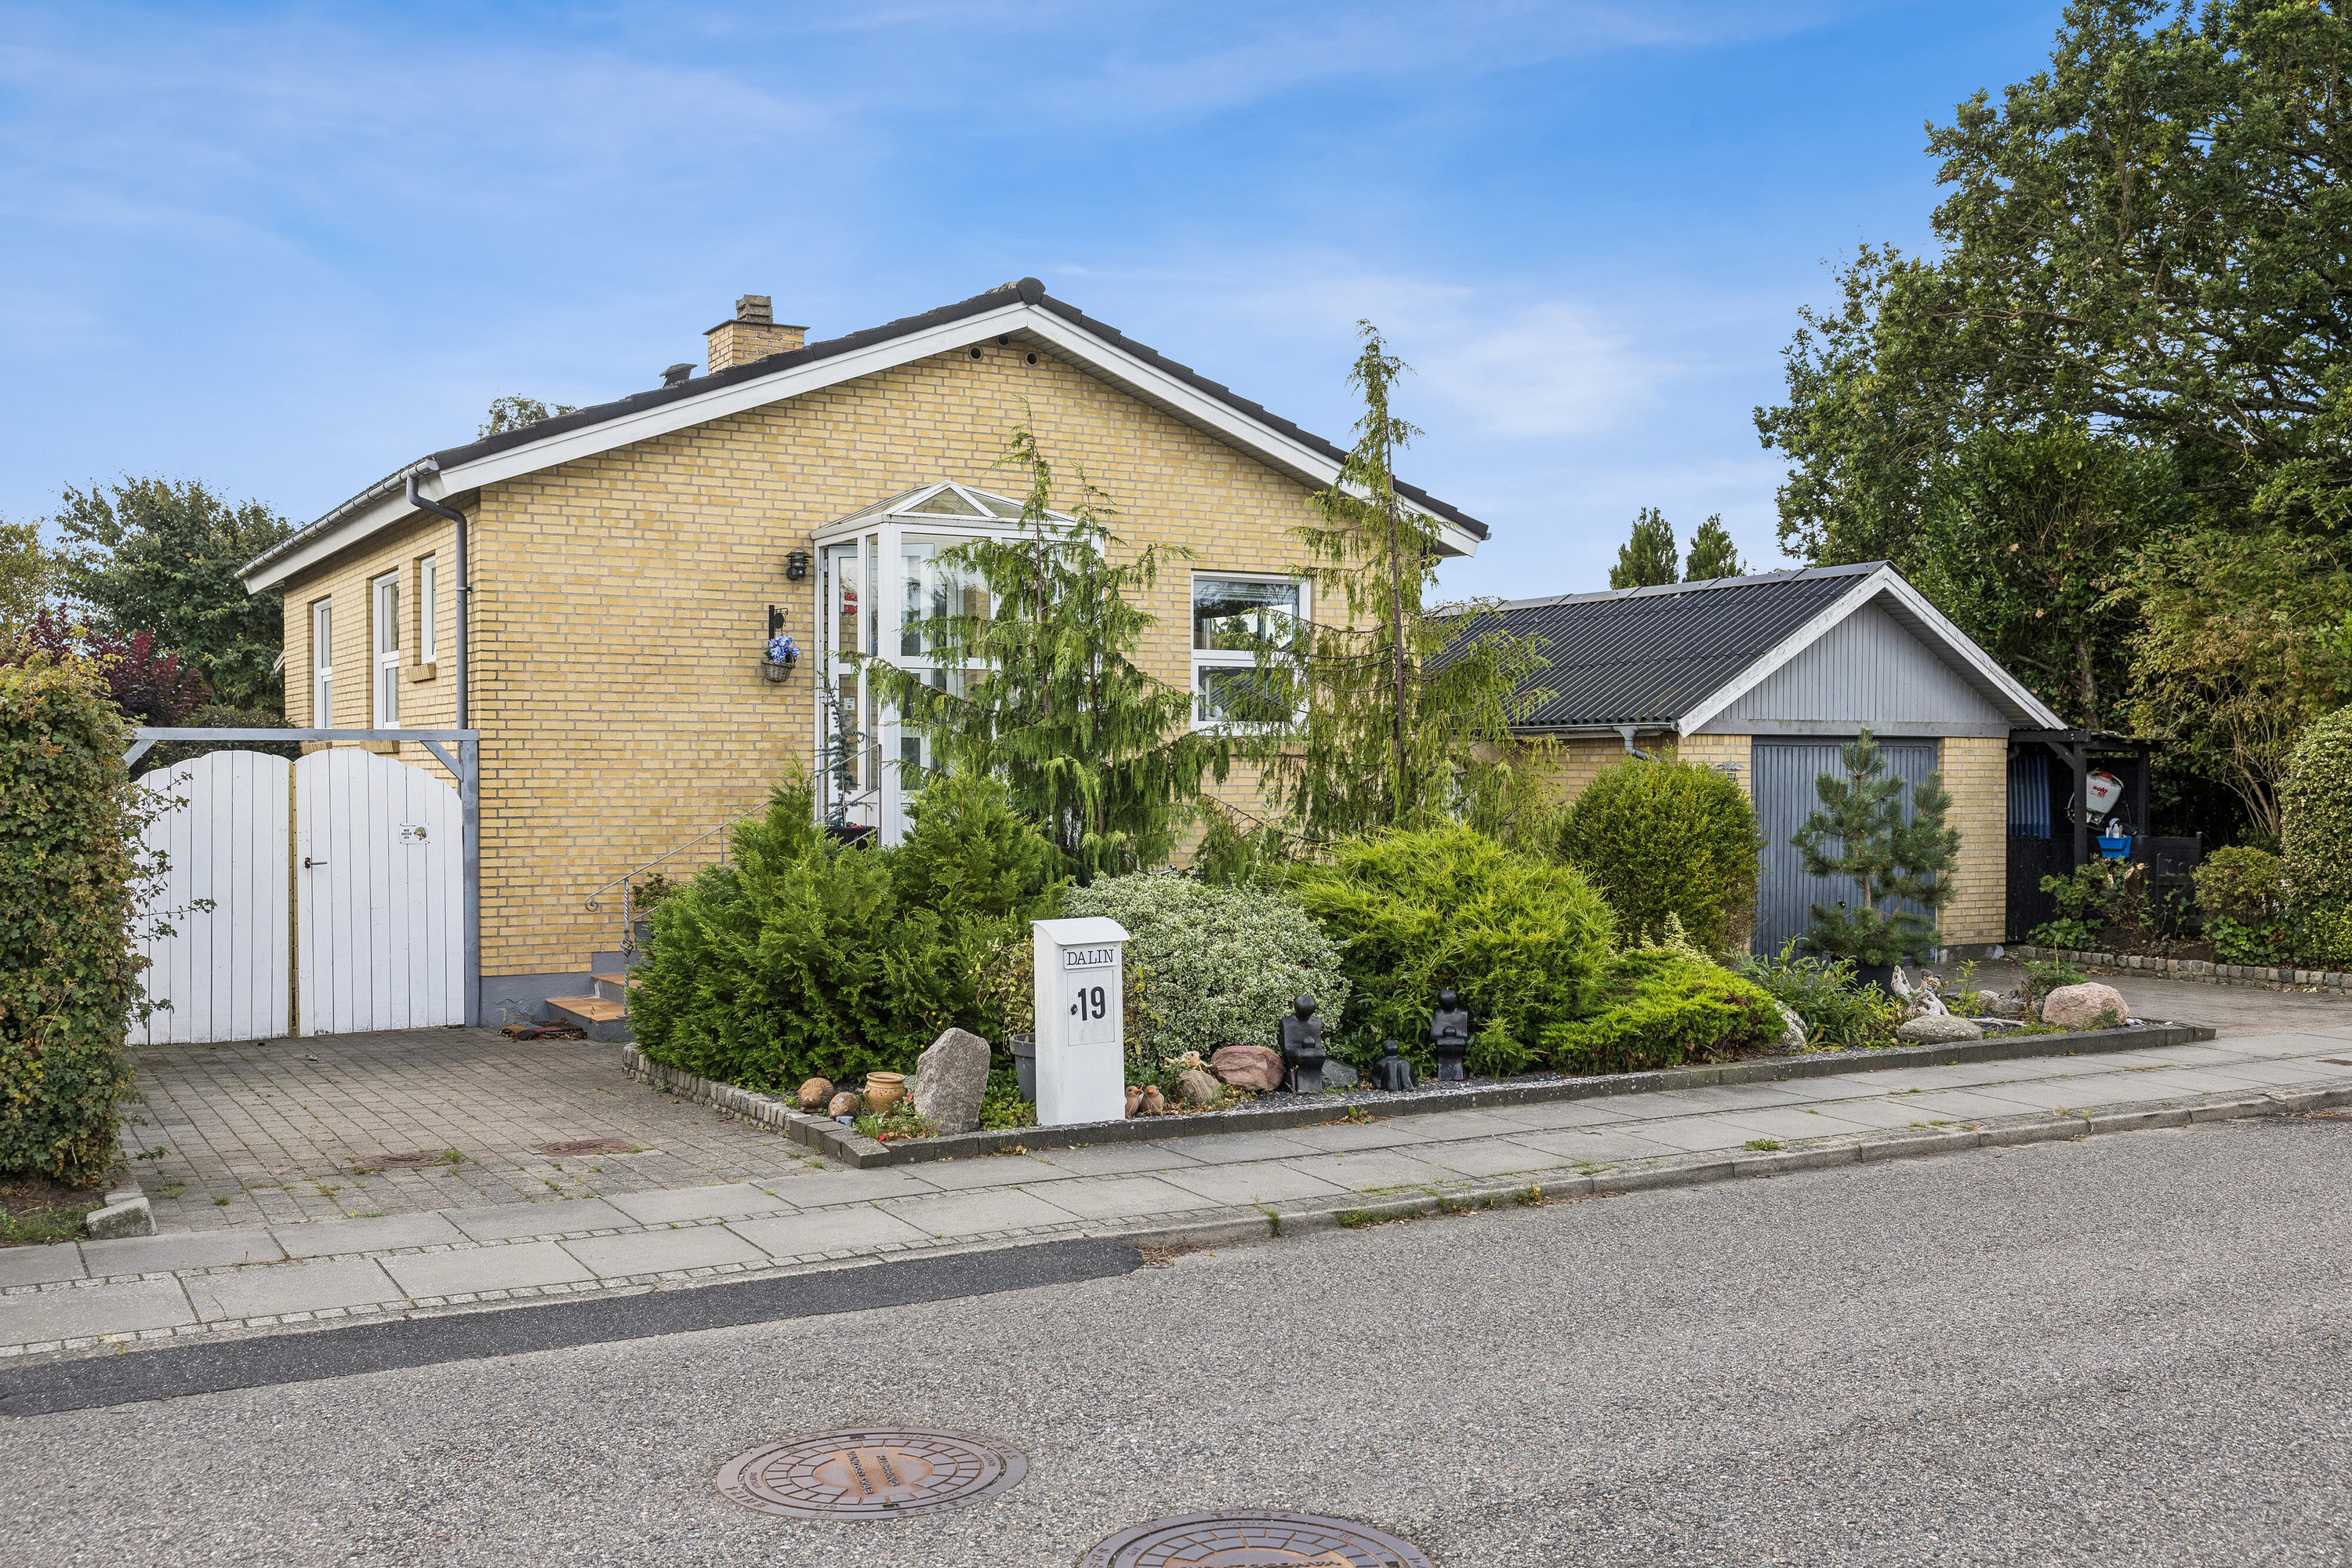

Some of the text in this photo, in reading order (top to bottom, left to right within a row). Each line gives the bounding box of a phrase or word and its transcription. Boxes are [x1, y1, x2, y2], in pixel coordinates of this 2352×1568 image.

[1066, 949, 1114, 966] DALIN
[1077, 986, 1105, 1021] 19
[847, 1451, 873, 1494] VANDSELSKAB
